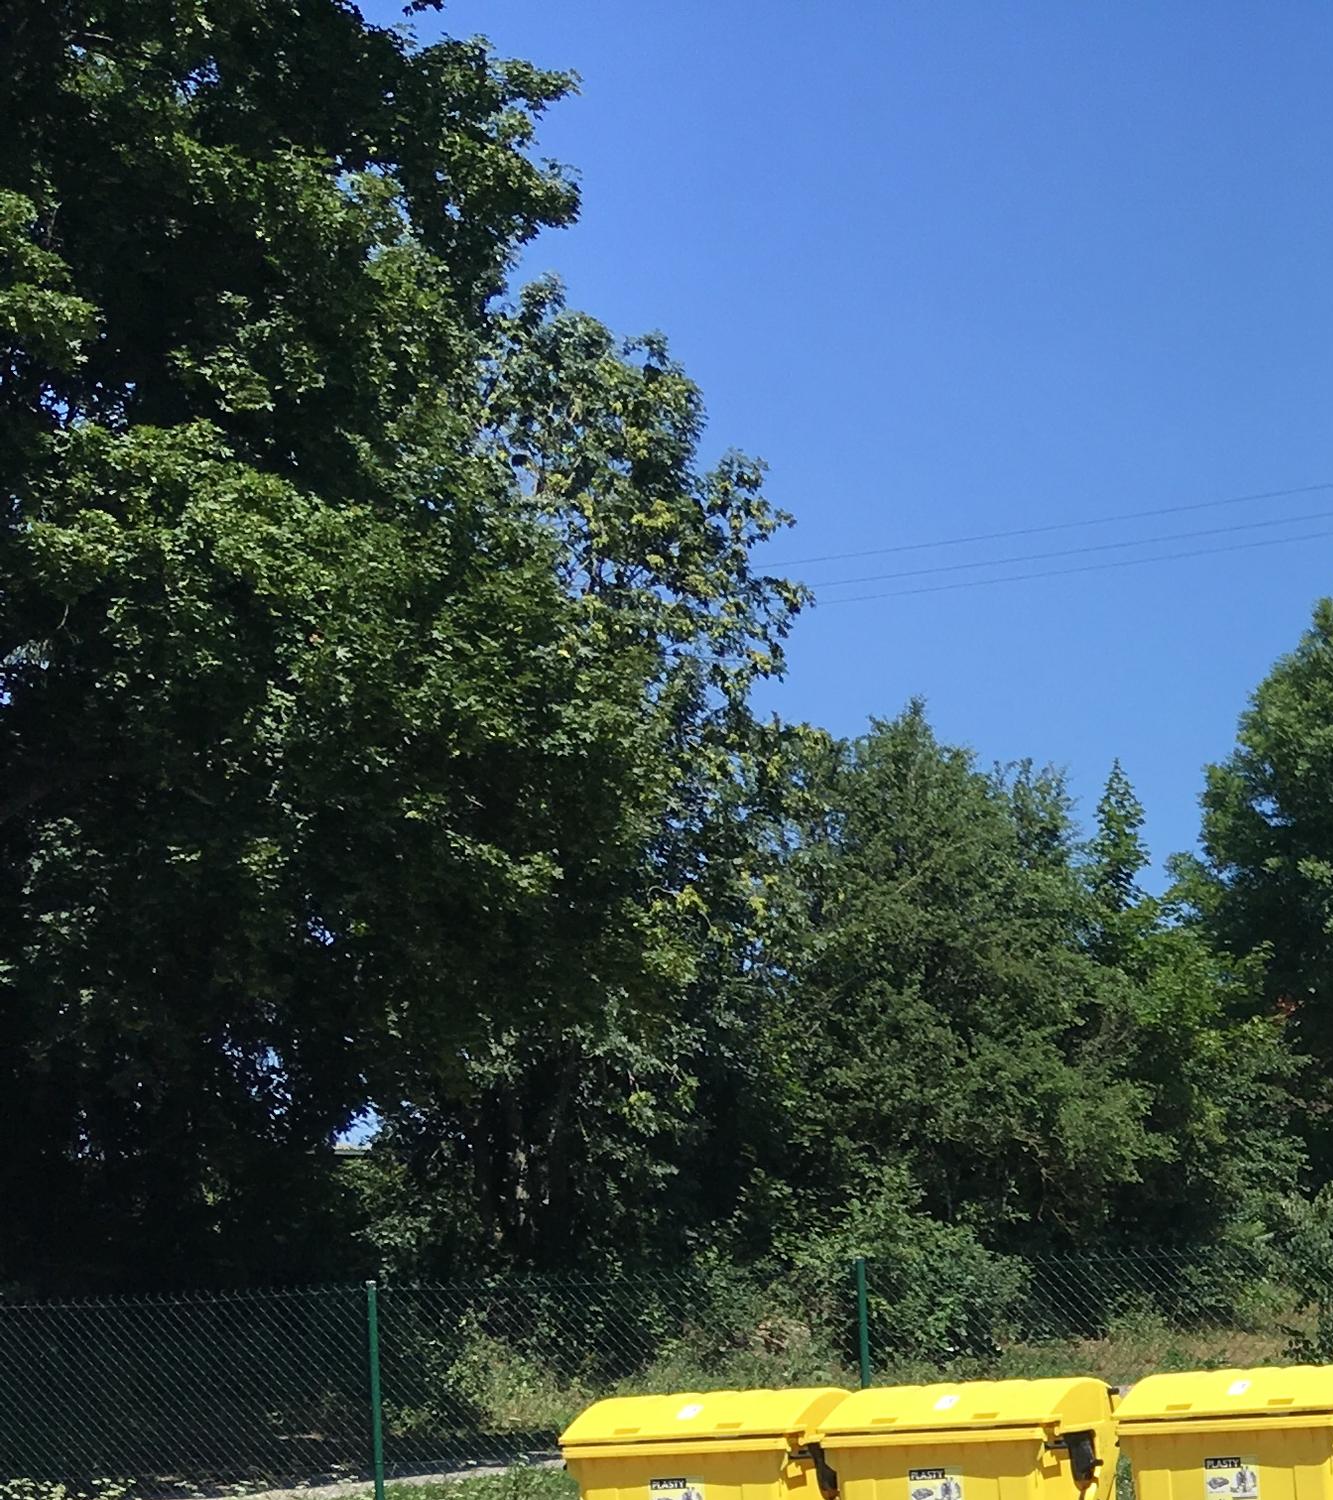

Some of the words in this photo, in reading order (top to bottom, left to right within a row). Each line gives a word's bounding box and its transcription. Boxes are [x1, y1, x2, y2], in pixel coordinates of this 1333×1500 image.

[1206, 1459, 1240, 1469] PLASTY
[910, 1470, 944, 1480] PLASTY
[652, 1480, 685, 1490] PLASTY
